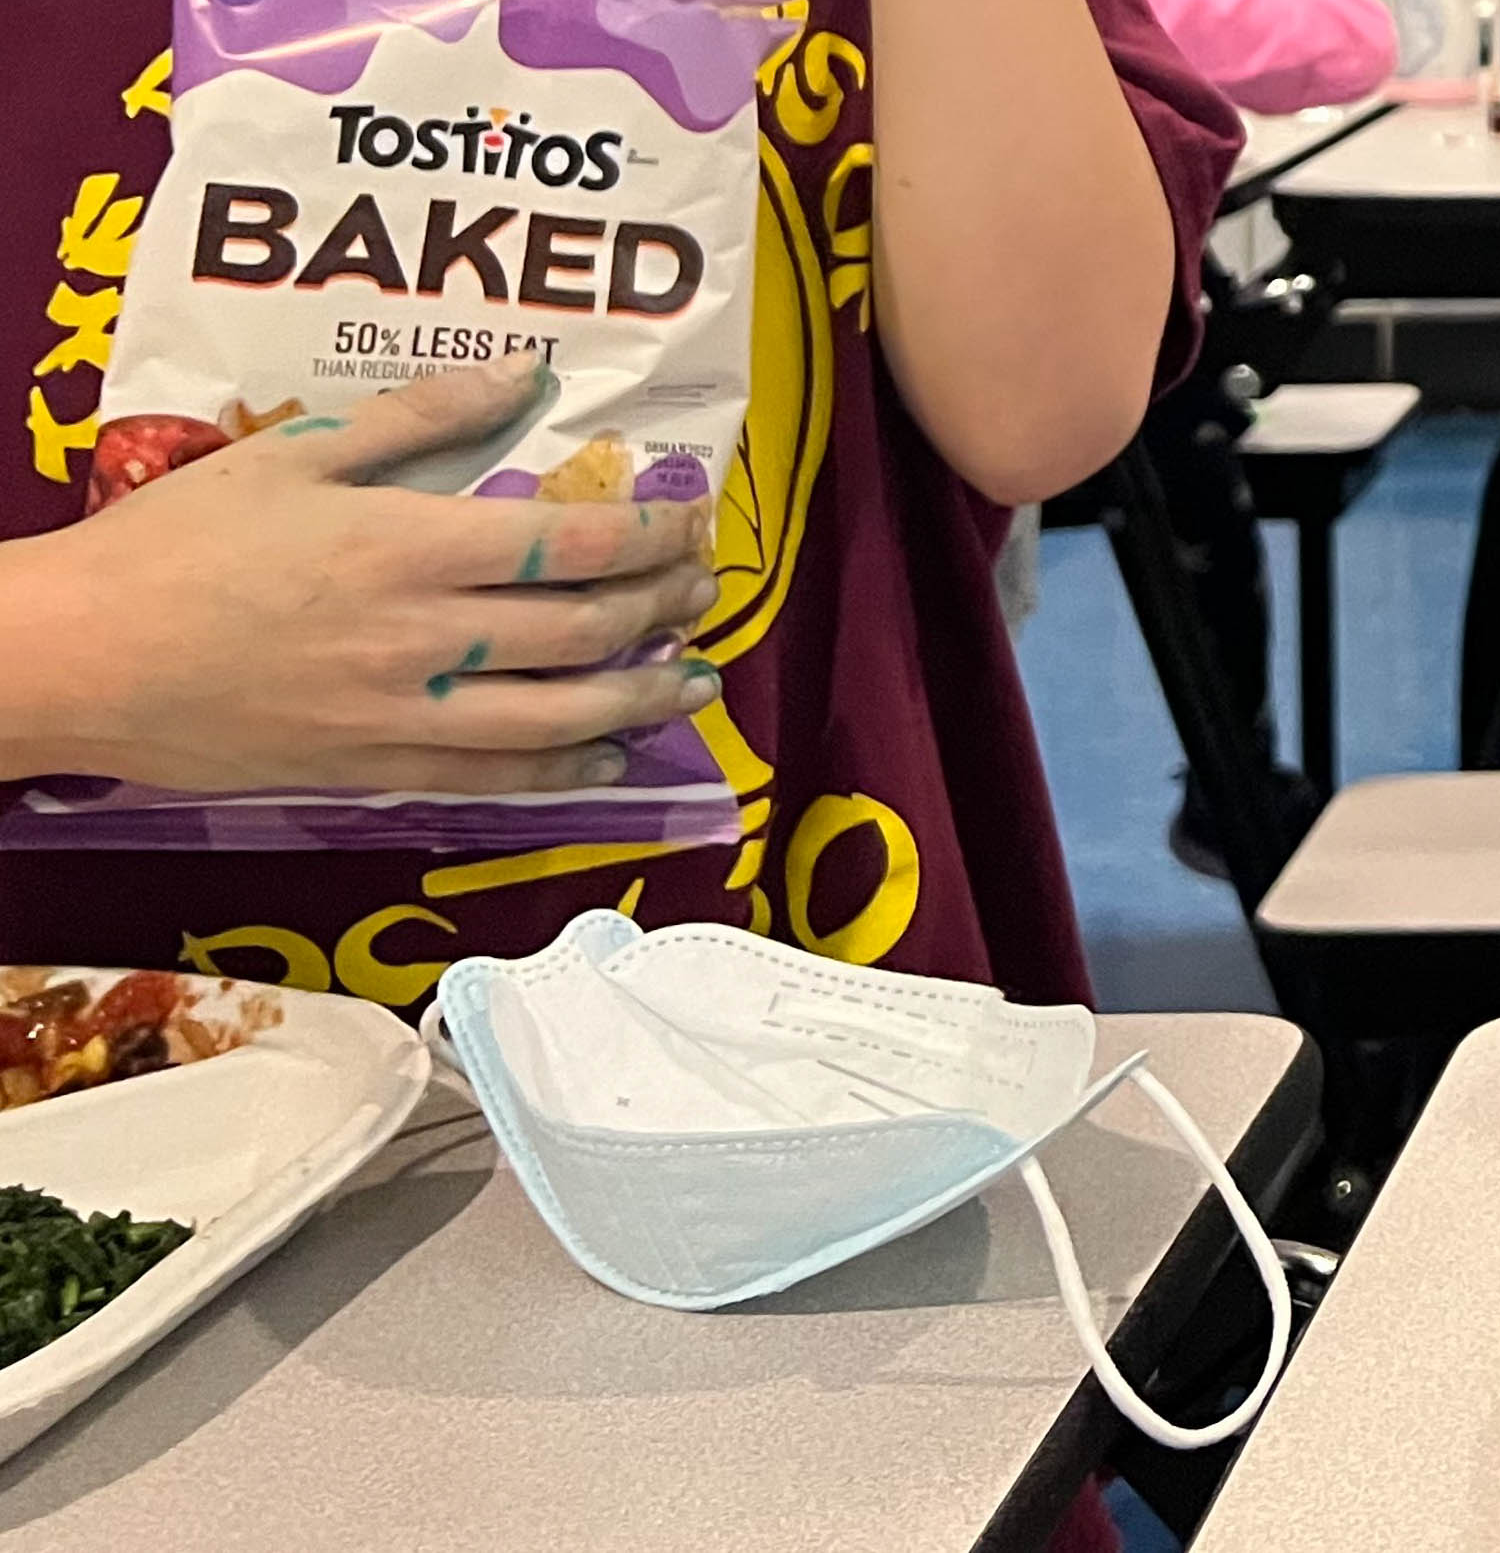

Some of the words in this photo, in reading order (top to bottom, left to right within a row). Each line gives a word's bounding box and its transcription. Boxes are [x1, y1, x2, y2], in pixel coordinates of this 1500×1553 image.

[193, 181, 705, 318] BAKED
[335, 321, 401, 356] 50%
[411, 325, 494, 361] LESS
[313, 357, 356, 377] THAN
